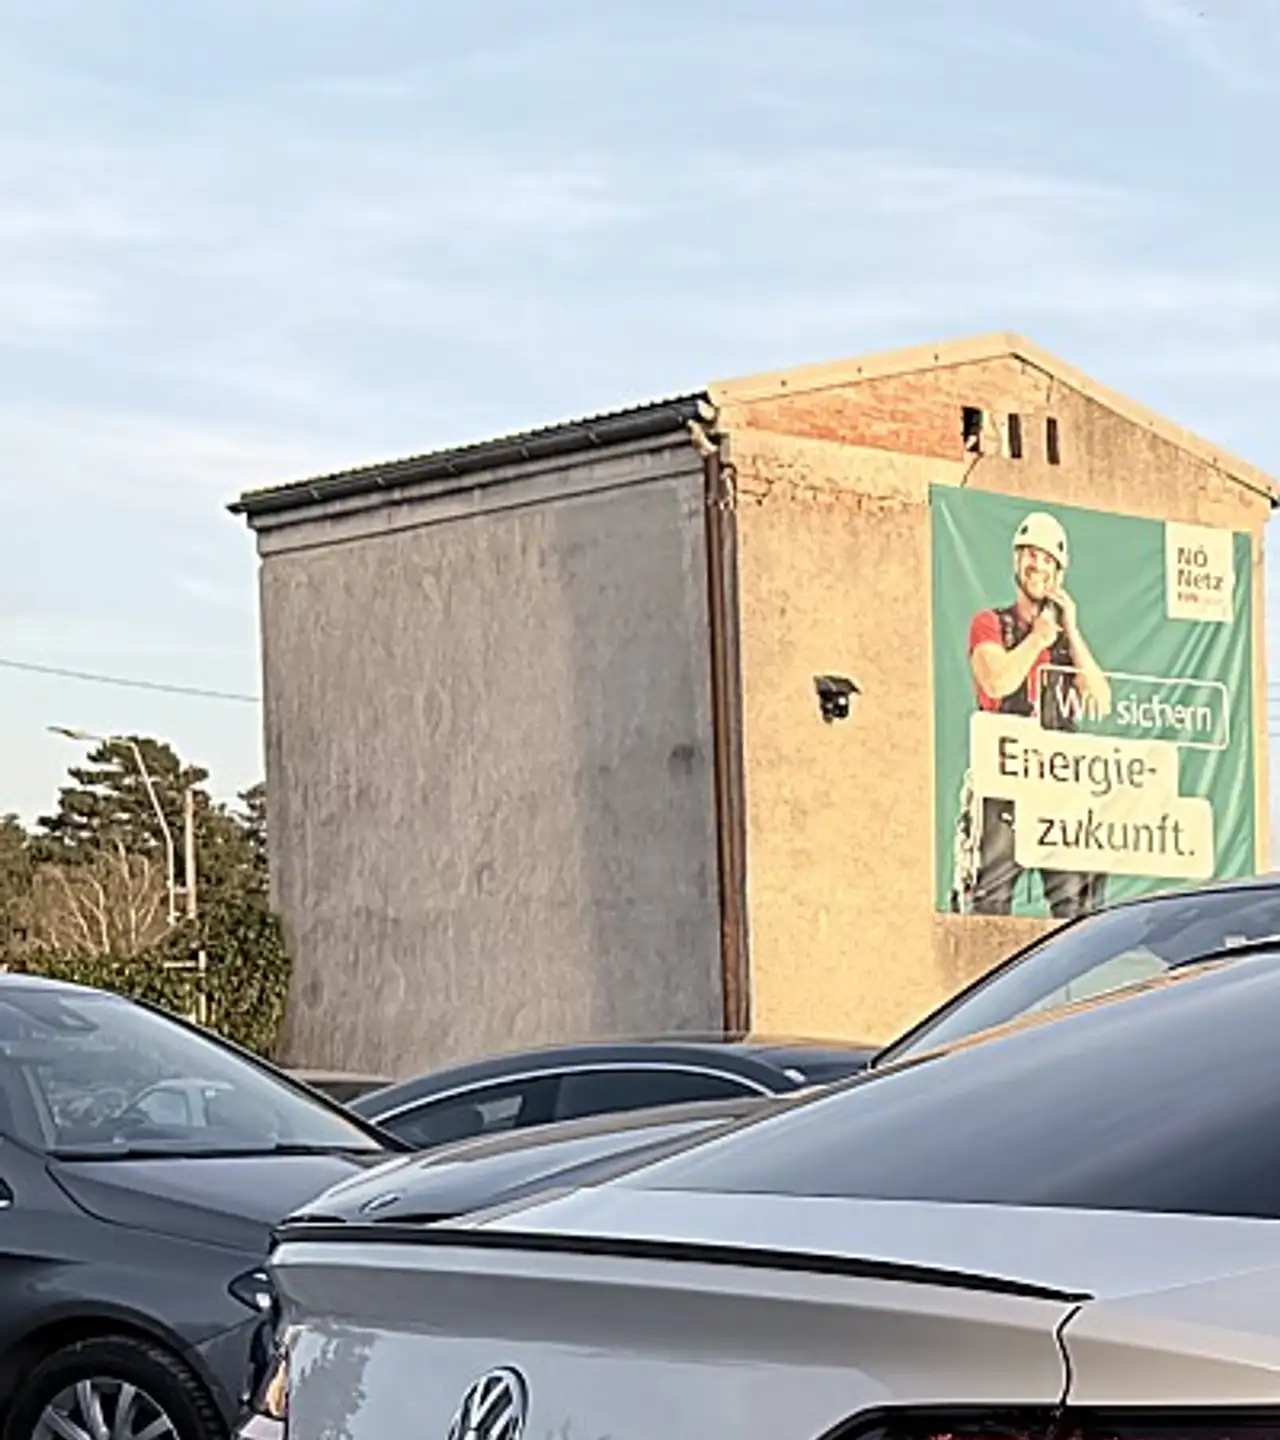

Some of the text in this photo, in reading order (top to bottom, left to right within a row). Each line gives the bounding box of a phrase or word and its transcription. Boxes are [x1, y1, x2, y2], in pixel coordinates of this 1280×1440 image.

[1177, 568, 1225, 591] Netz
[1116, 694, 1212, 732] sichern
[998, 735, 1158, 797] Energie-
[1037, 807, 1196, 857] zukunft.
